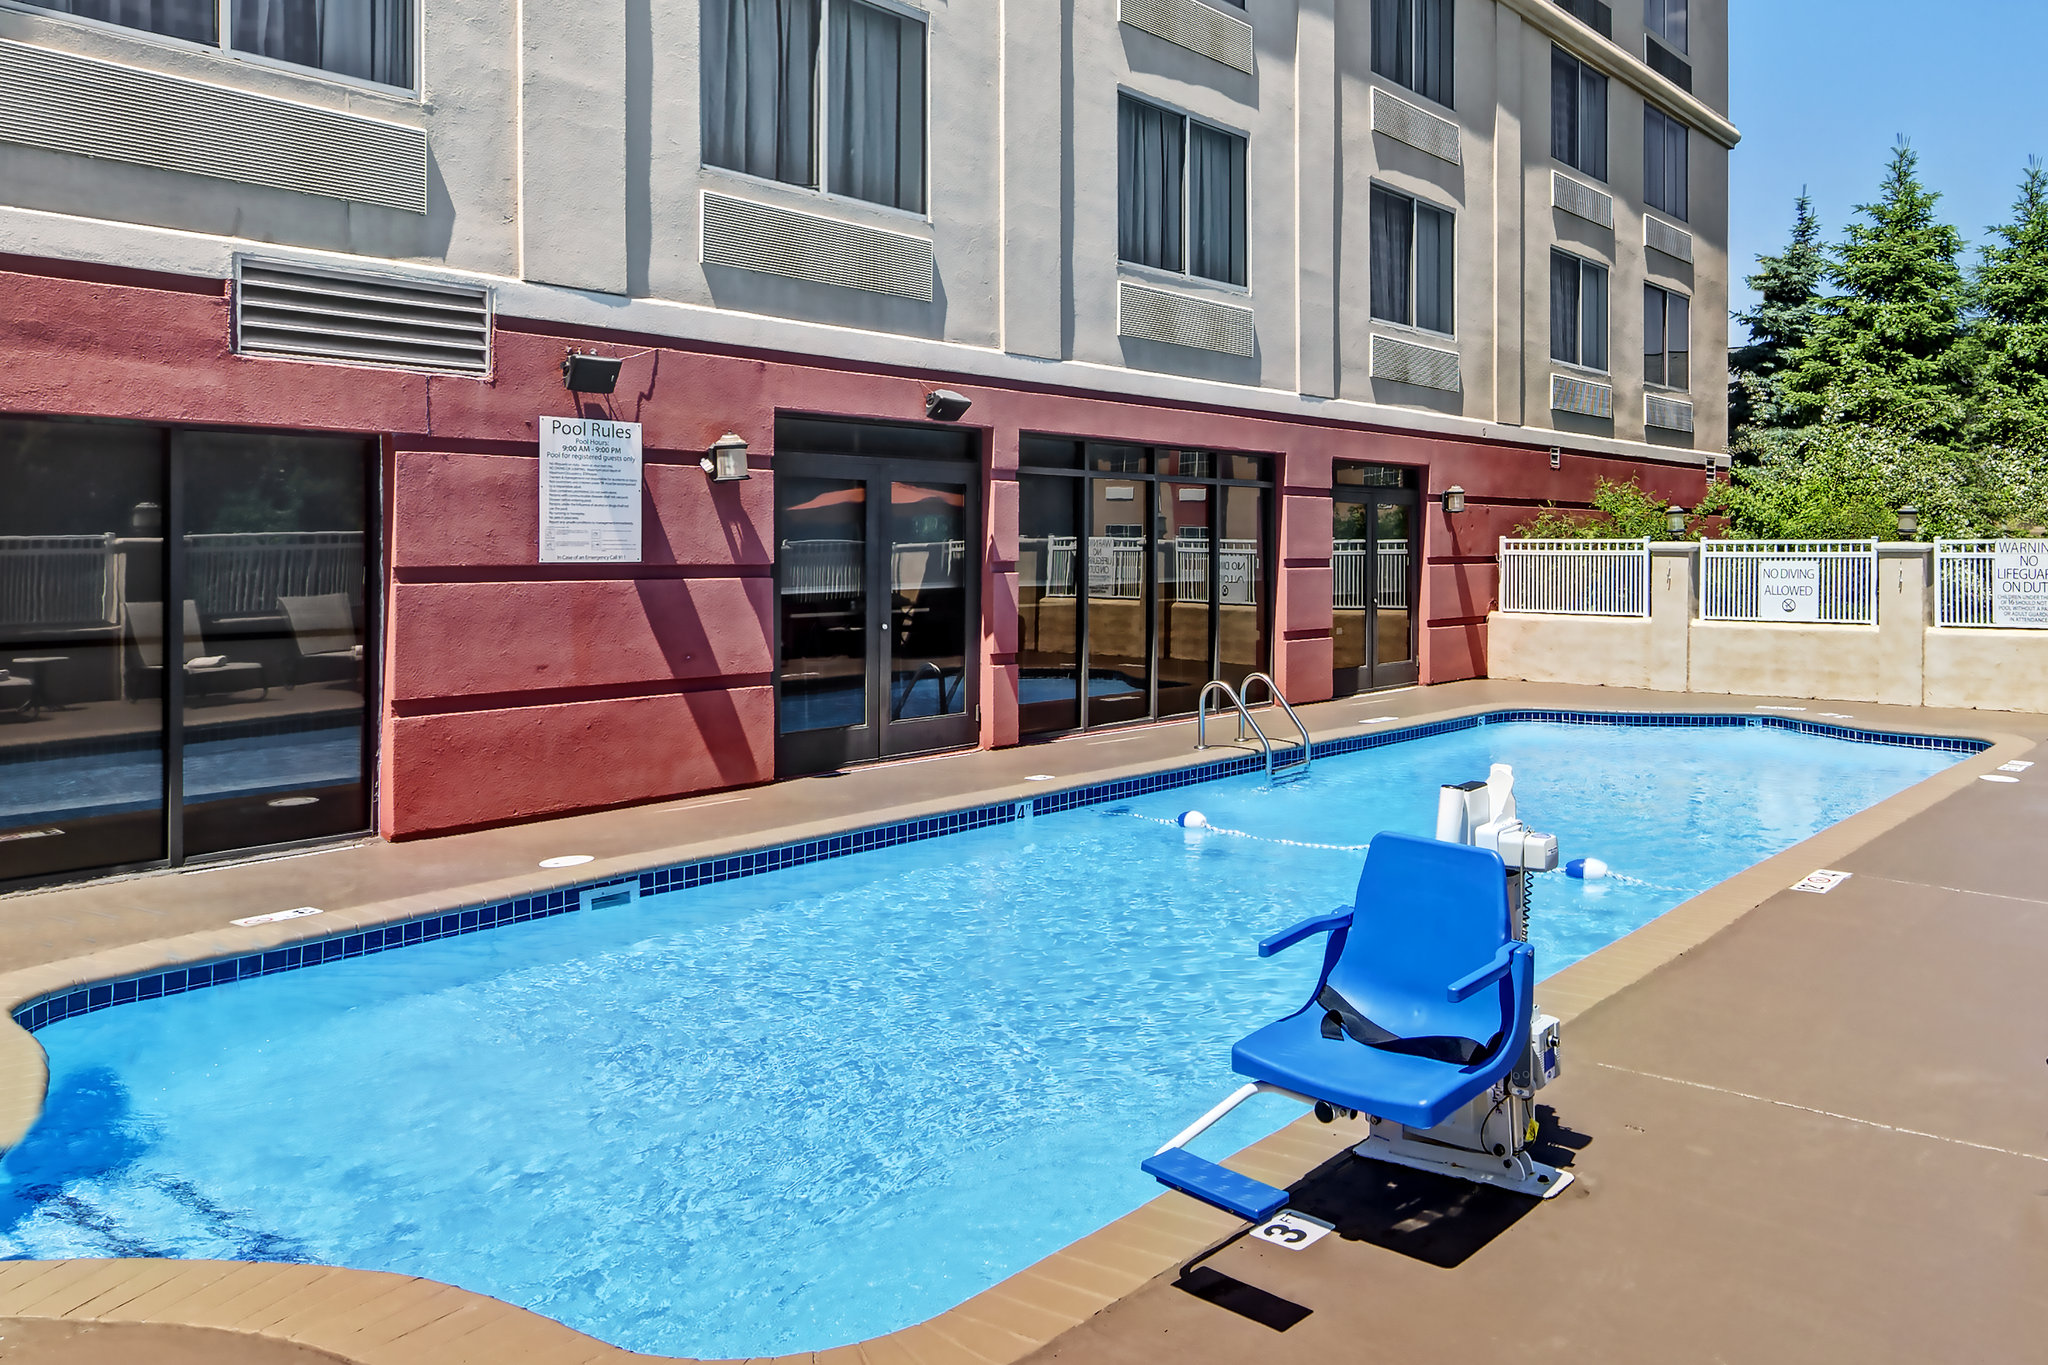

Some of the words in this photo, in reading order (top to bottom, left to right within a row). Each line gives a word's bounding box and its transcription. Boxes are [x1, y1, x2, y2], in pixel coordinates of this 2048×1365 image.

[552, 419, 586, 437] Pool
[592, 422, 632, 439] Rules
[571, 453, 602, 461] registered
[603, 455, 622, 463] guests
[2020, 555, 2038, 567] NO
[1763, 568, 1779, 579] NO
[1780, 568, 1815, 579] DIVING
[1764, 585, 1813, 596] ALLOWED
[2002, 581, 2021, 593] ON
[1017, 804, 1025, 820] 4
[1263, 1224, 1308, 1243] 3
